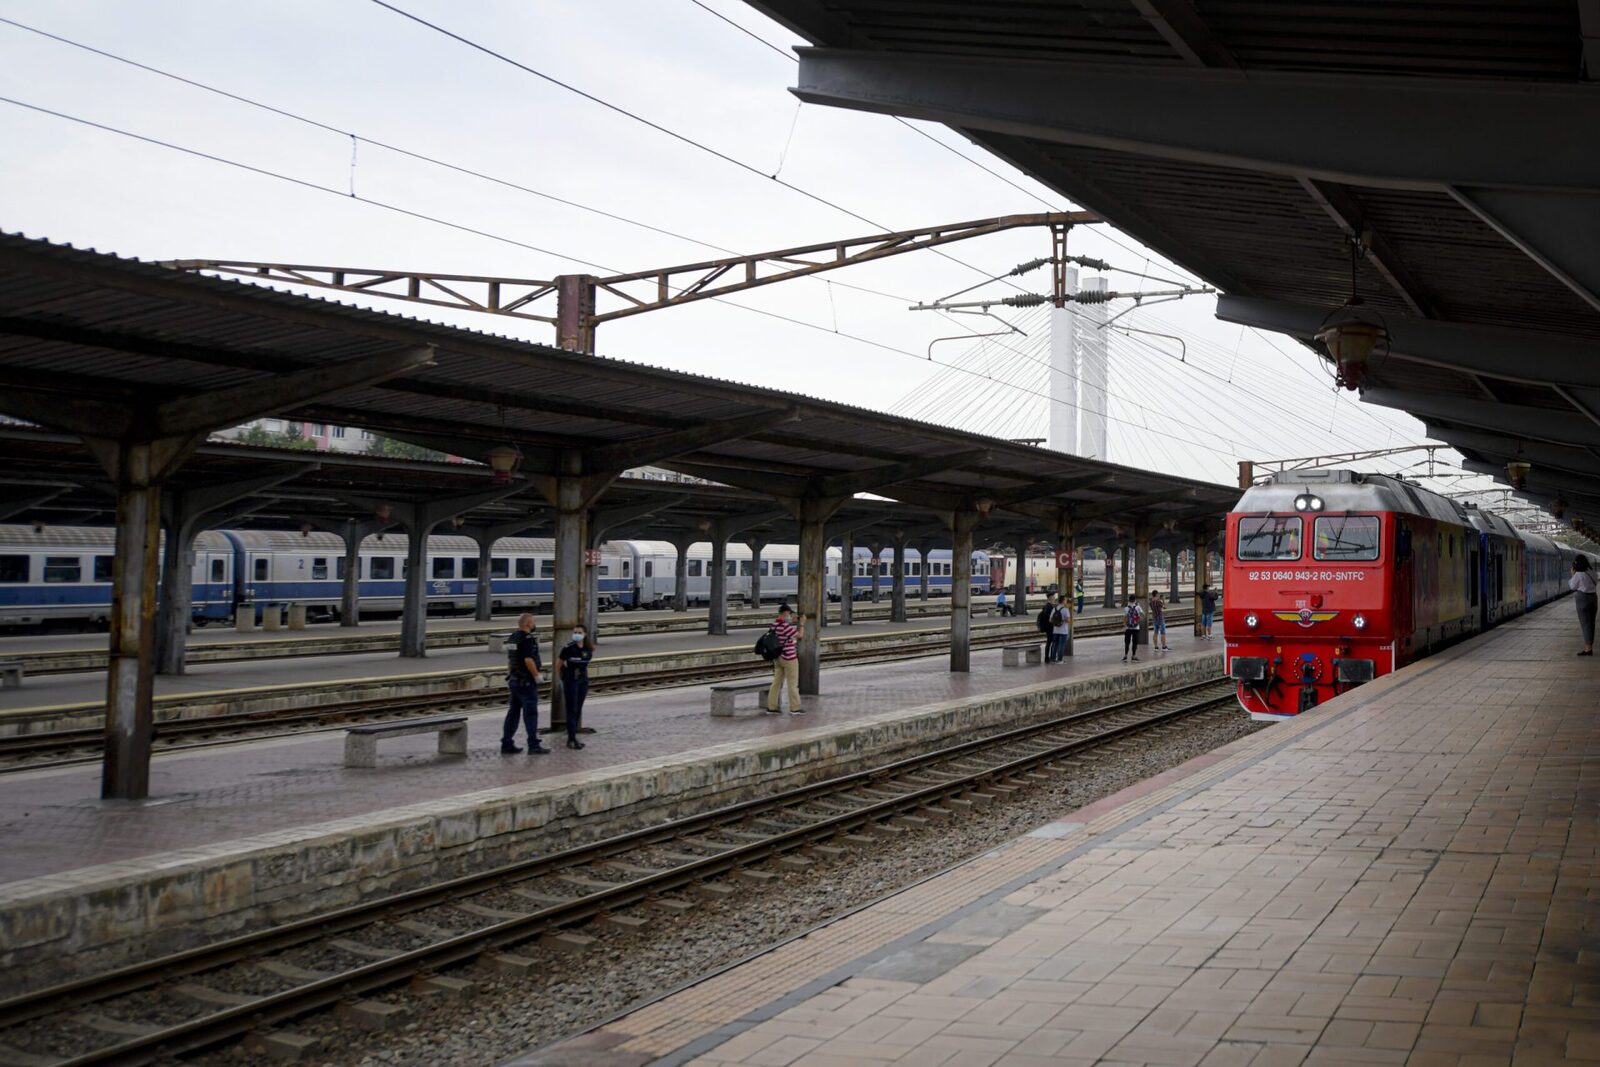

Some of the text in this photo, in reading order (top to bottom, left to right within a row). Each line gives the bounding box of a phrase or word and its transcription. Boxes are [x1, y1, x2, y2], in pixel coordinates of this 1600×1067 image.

[299, 559, 305, 569] 2
[1059, 553, 1070, 566] C
[1249, 571, 1365, 581] 92 53 0640 943-2 RO-SNTFC
